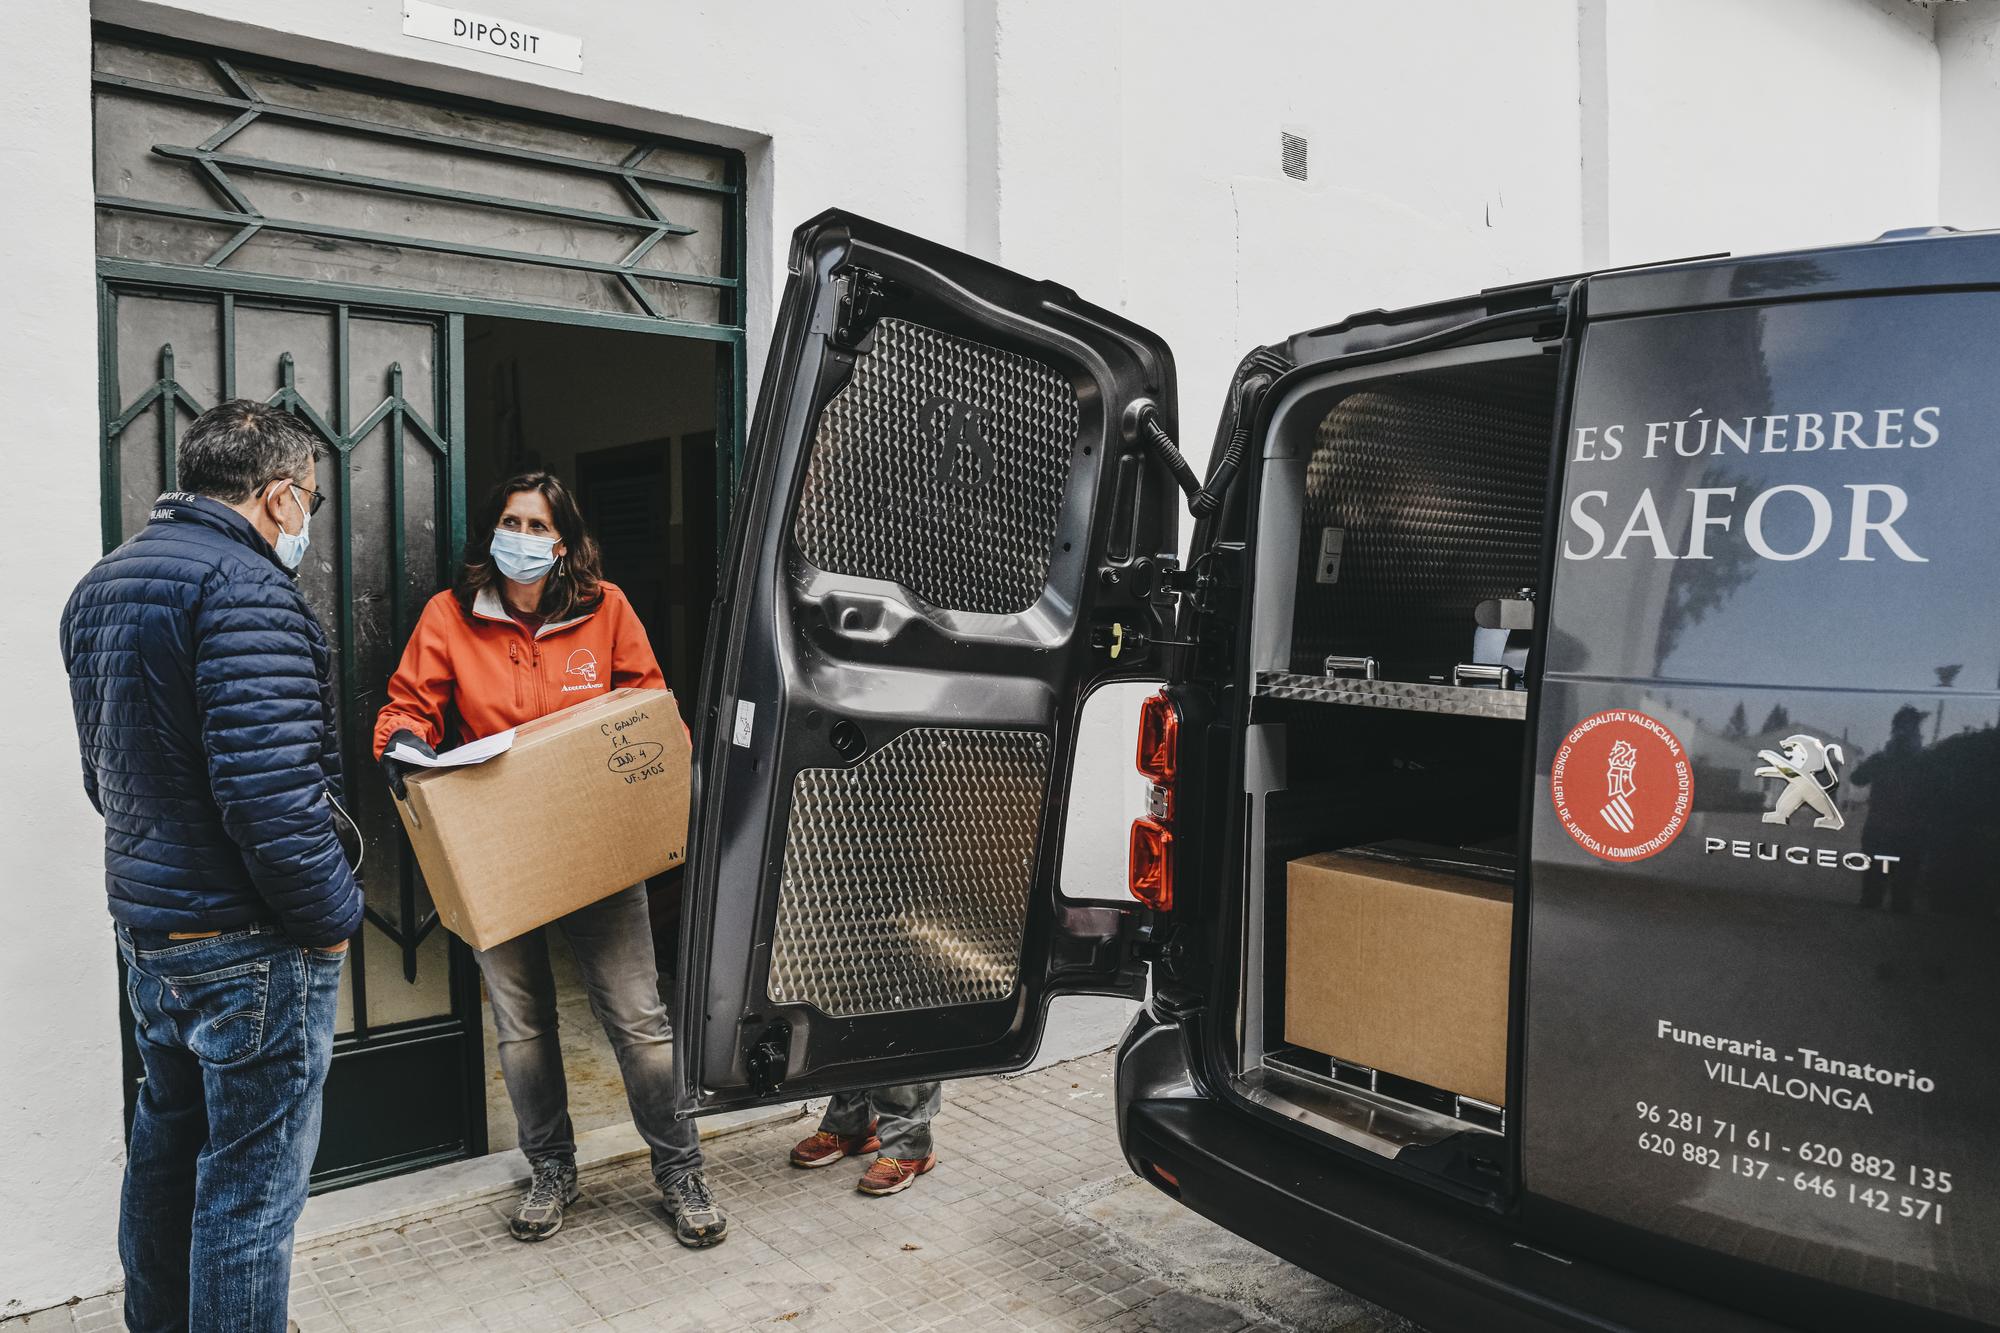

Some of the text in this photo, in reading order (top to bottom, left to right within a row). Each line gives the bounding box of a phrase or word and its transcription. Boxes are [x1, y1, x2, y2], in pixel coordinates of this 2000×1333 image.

[454, 18, 540, 54] DIPÒSIT
[1572, 407, 1941, 462] ES FÚNEBRES
[1563, 483, 1930, 563] SAFOR
[1568, 712, 1681, 757] GENERALITAT VALENCIANA
[1553, 745, 1572, 808] CONSELLERIA
[1674, 760, 1689, 816] PÚBLIQUES
[1559, 807, 1572, 822] DE
[1566, 822, 1601, 853] JUSTÍCIA
[1607, 815, 1682, 858] ADMINISTRACIONS
[1705, 837, 1901, 875] PEUGEOT
[1657, 1019, 1778, 1063] Funeraria
[1798, 1048, 1935, 1093] Tanatorio
[1704, 1060, 1873, 1114] VILLALONGA
[1636, 1101, 1661, 1123] 96
[1667, 1109, 1702, 1134] 281
[1713, 1120, 1735, 1142] 71
[1747, 1129, 1770, 1151] 61
[1799, 1142, 1843, 1168] 620
[1850, 1153, 1896, 1181] 882
[1909, 1165, 1953, 1193] 135
[1638, 1132, 1676, 1156] 620
[1682, 1143, 1721, 1169] 882
[1732, 1155, 1770, 1180] 137
[1793, 1171, 1837, 1198] 646
[1849, 1183, 1891, 1212] 142
[1899, 1196, 1942, 1224] 571
